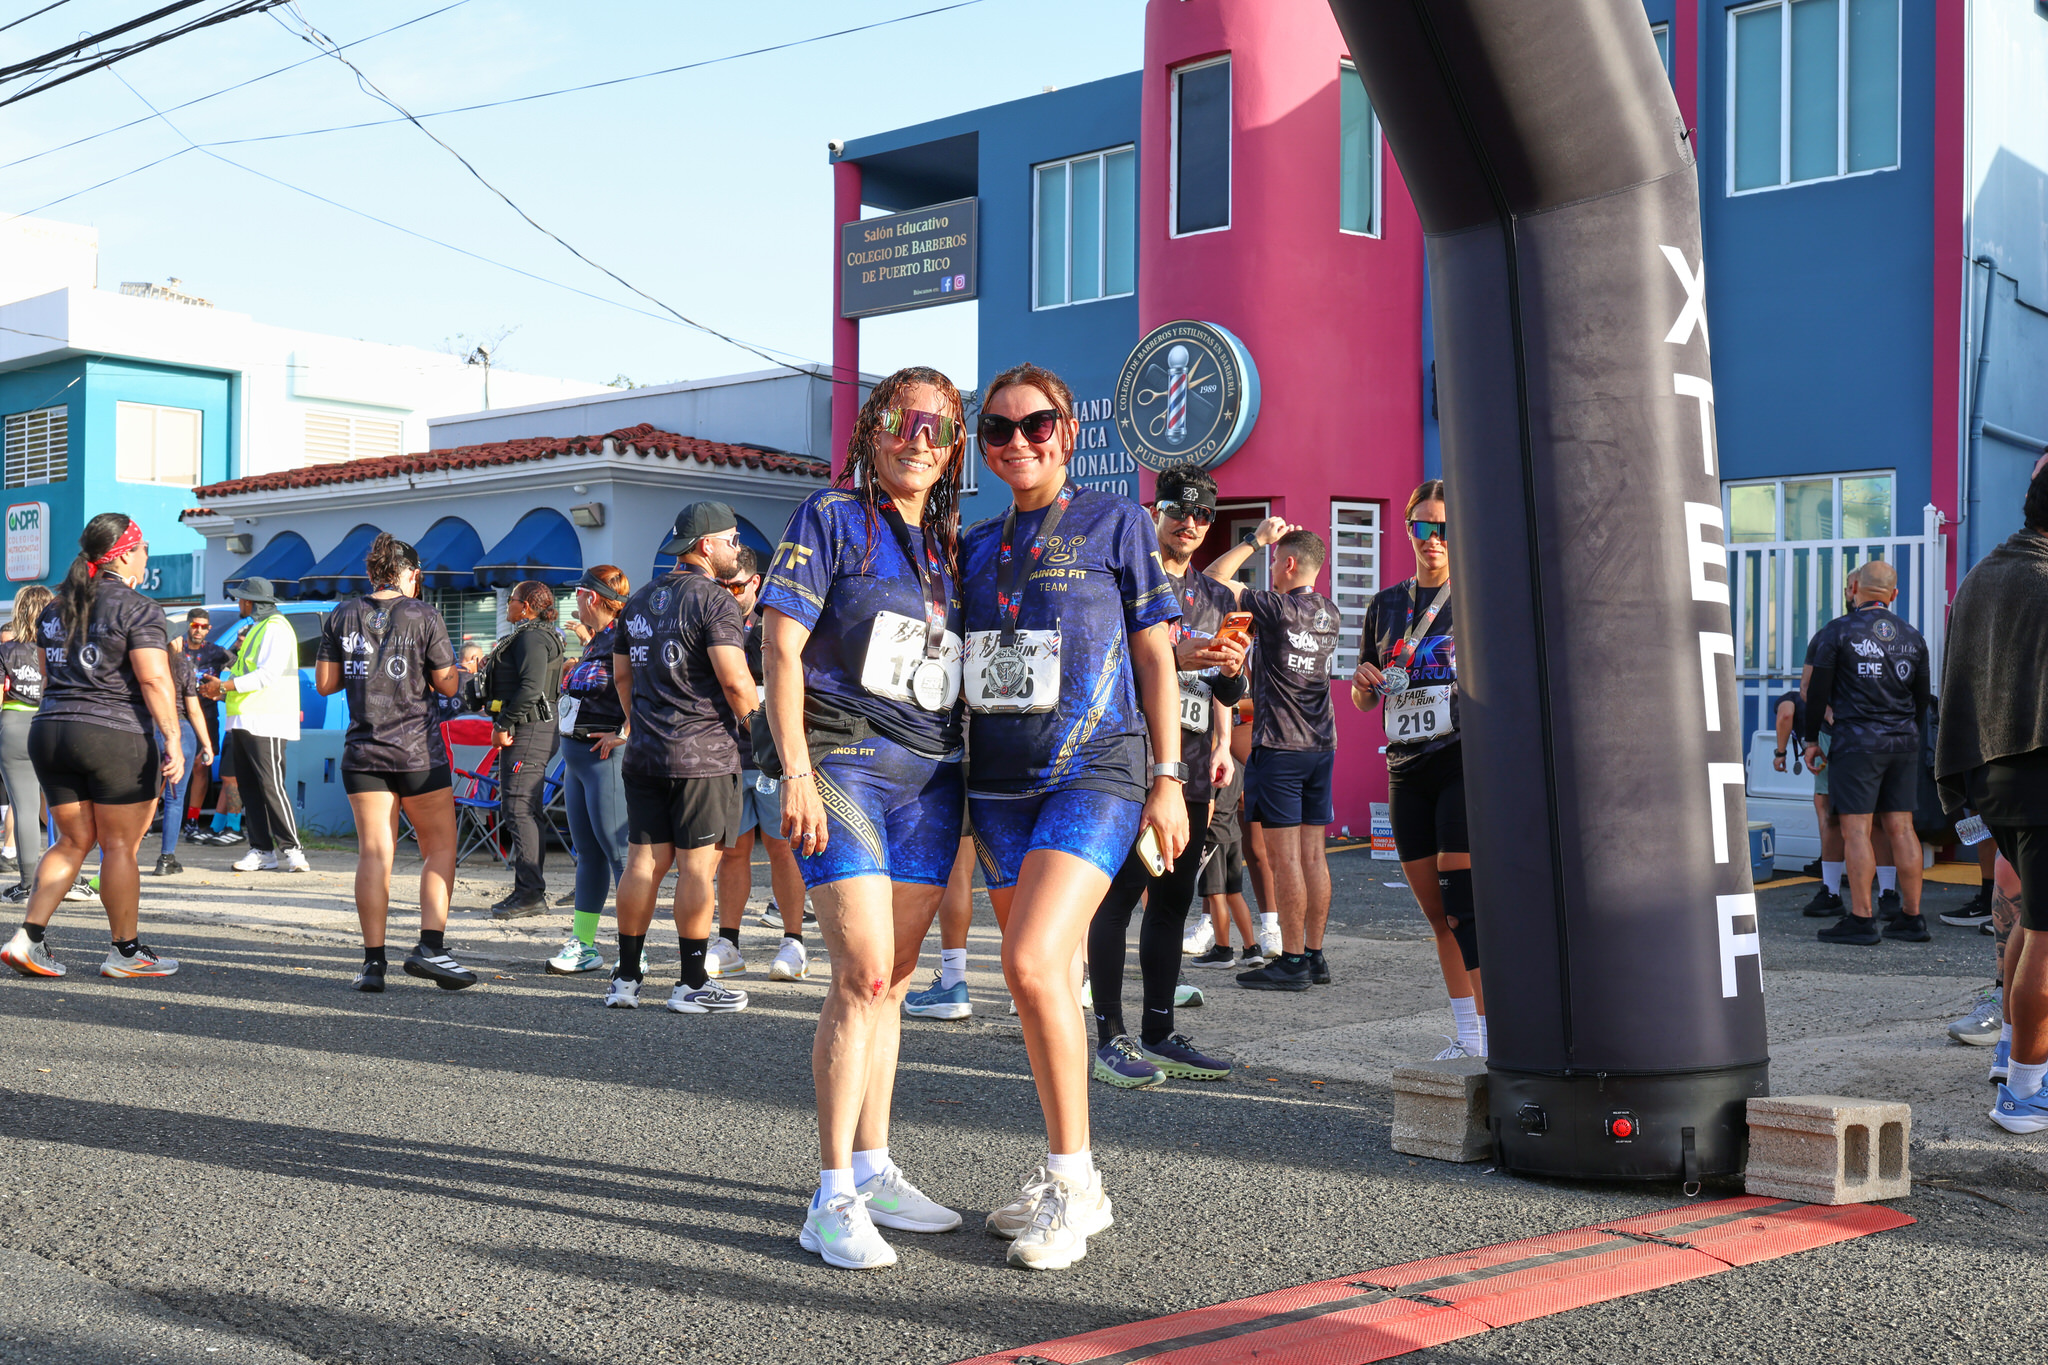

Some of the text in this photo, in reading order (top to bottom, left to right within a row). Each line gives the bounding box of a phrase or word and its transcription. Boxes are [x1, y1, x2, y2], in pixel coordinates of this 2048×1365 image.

[864, 216, 949, 243] Salón Educativo
[847, 247, 893, 266] COLEGIO
[911, 233, 967, 255] BARBEROS
[879, 262, 921, 281] PUERTO
[923, 257, 950, 273] RICO
[1119, 372, 1134, 411] COLEGIO
[1129, 357, 1140, 372] DE
[1137, 329, 1172, 360] BARBEROS
[1172, 328, 1178, 337] Y
[1178, 327, 1215, 347] ESTILISTAS
[1212, 343, 1223, 355] EN
[1199, 384, 1217, 394] 1989
[1134, 439, 1217, 468] PUERTO RICO
[1183, 486, 1199, 502] 24
[1068, 569, 1087, 580] FIT
[1039, 582, 1068, 592] TEAM
[629, 645, 650, 662] EME
[344, 660, 370, 675] EME
[1287, 653, 1316, 671] EME
[1857, 662, 1883, 675] EME
[1187, 687, 1205, 699] RUN
[1404, 689, 1428, 700] FADE
[1416, 696, 1436, 707] RUN
[1180, 698, 1202, 723] 18
[1398, 710, 1436, 736] 219
[859, 748, 876, 756] FIT
